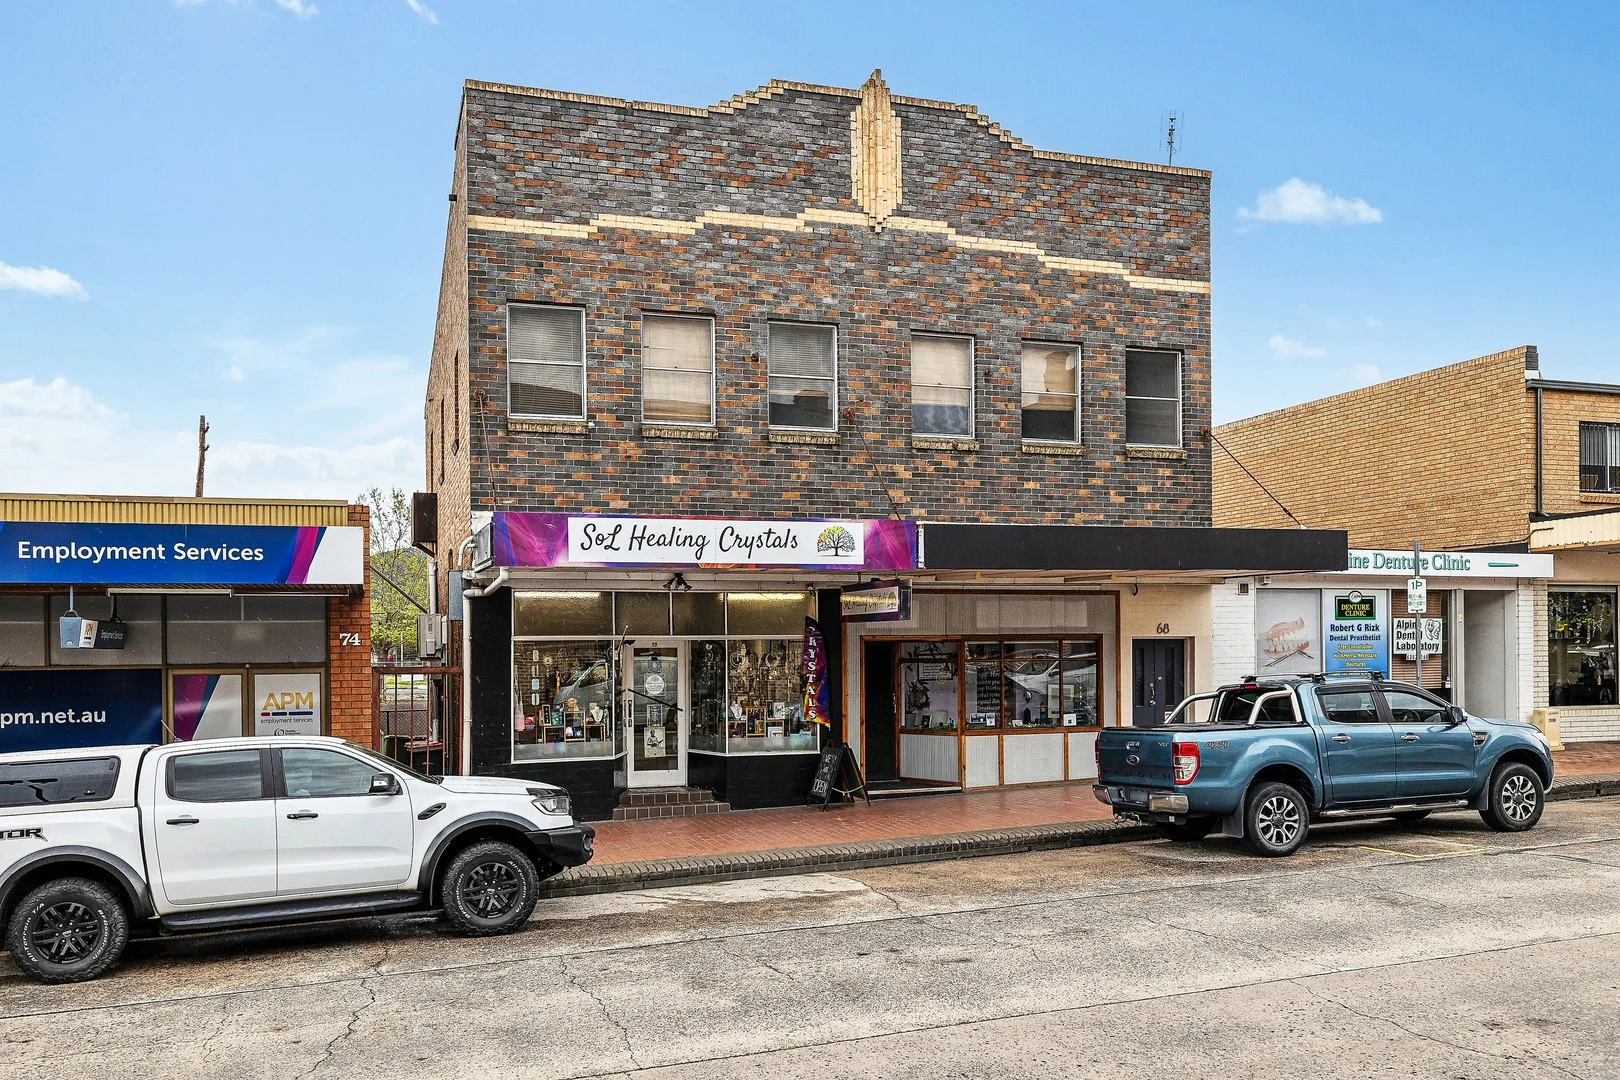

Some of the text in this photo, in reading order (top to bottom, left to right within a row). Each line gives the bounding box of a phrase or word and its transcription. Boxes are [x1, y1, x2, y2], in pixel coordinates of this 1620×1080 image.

[581, 522, 798, 560] SoL Healing Crystals
[18, 541, 264, 563] Employment Services
[1432, 553, 1470, 571] Clinic
[1156, 622, 1170, 634] 68
[1330, 624, 1380, 632] Robert G Rizk
[1396, 620, 1422, 631] Alpin
[340, 633, 361, 646] 74
[1396, 631, 1422, 640] Dentl
[1396, 642, 1439, 653] Laboatory
[262, 692, 314, 710] APM
[0, 708, 106, 728] pm.net.au
[1103, 769, 1171, 780] RANGER
